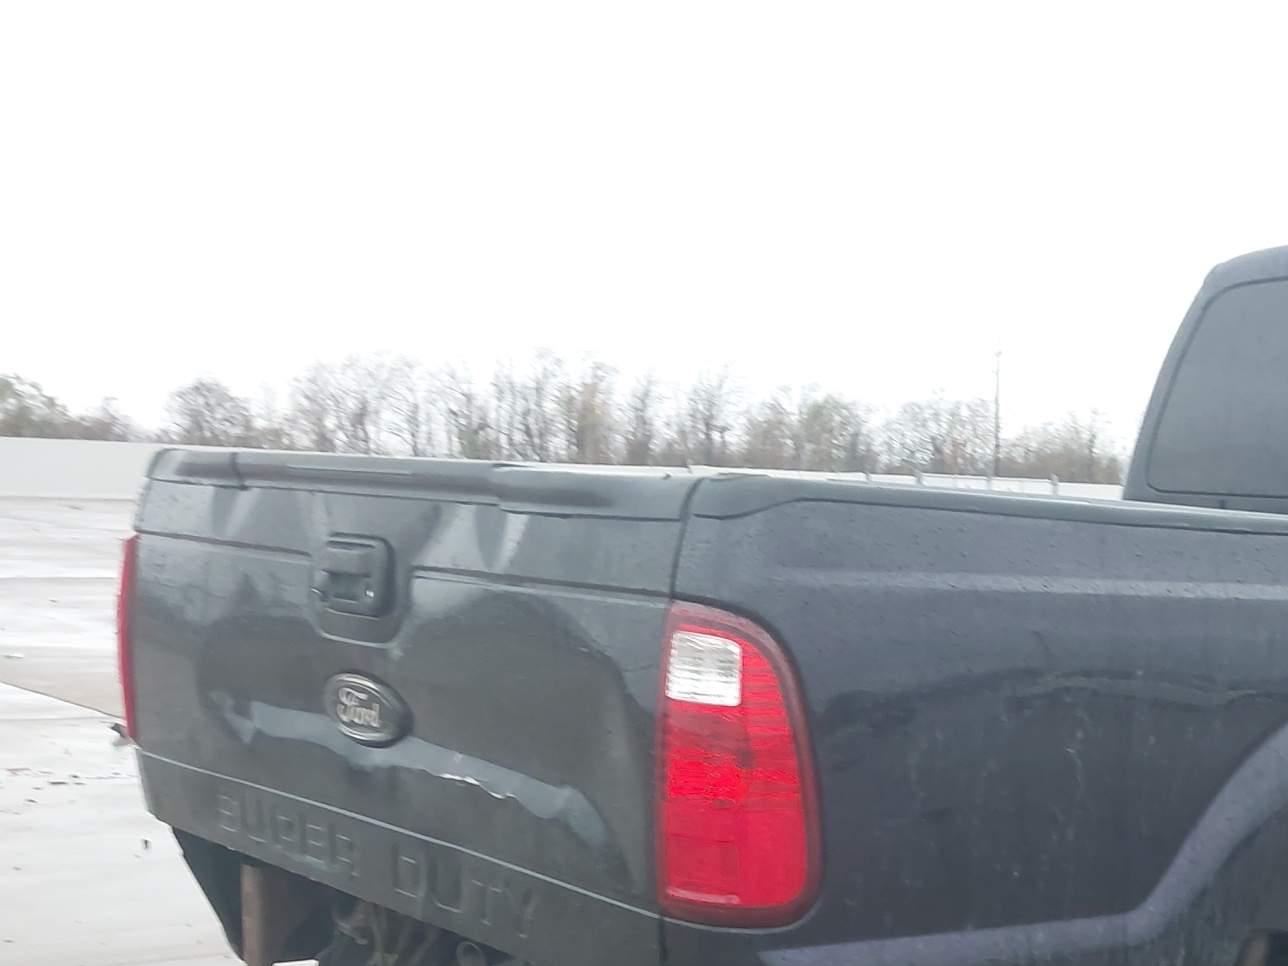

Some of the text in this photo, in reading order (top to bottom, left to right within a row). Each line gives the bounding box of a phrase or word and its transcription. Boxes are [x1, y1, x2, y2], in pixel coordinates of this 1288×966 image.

[336, 686, 381, 728] Ford
[216, 793, 537, 938] SUPER DUTY
